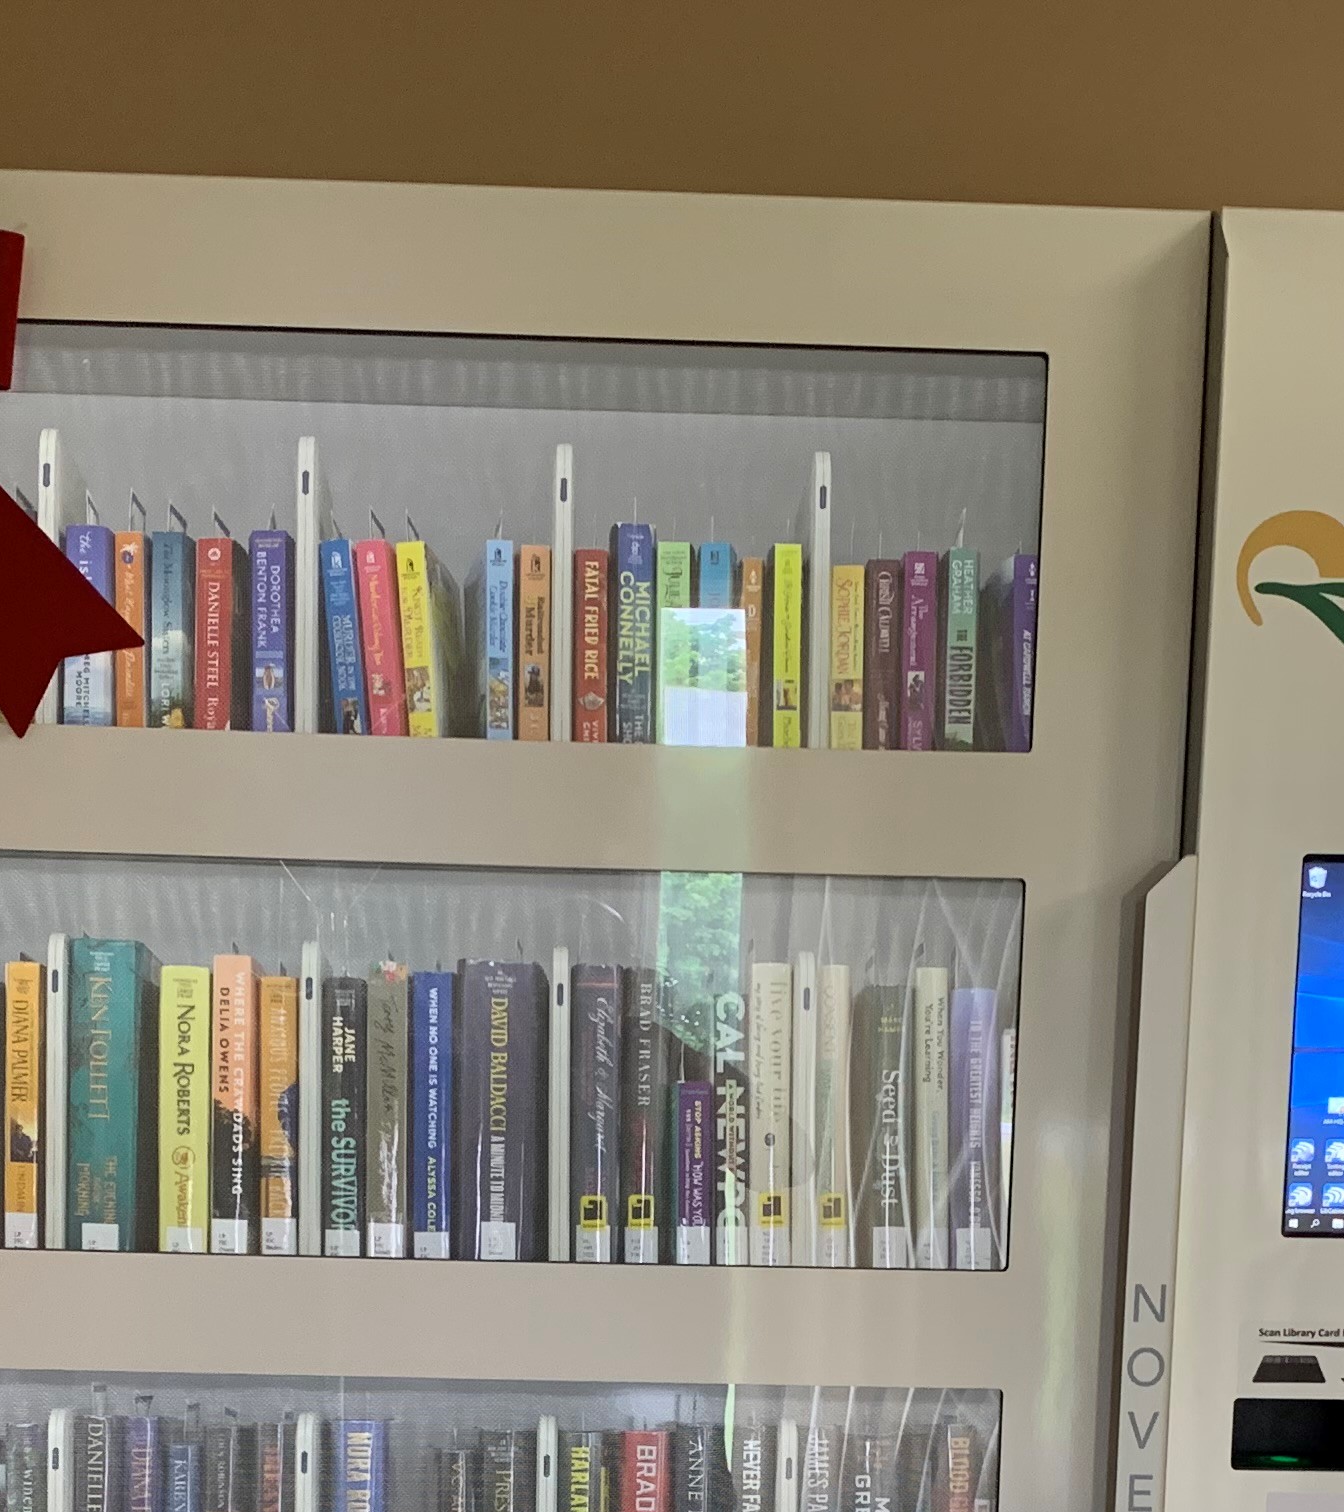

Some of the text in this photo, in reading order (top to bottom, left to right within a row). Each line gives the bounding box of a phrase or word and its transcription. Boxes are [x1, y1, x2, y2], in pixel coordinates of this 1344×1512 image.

[256, 551, 267, 648] BENTON FRANK
[270, 565, 280, 633] DOROTHEA
[584, 561, 600, 680] FATAL FRIED RICE
[951, 560, 963, 614] GRAHAM
[963, 560, 974, 614] HEATHER
[206, 582, 219, 688] DANIELLE STEEL
[618, 571, 634, 685] CONNELLY
[634, 582, 650, 677] MICHAEL
[837, 579, 852, 675] SOPHIE JORDAN
[948, 646, 973, 724] FORBIDDEN
[428, 988, 438, 1023] WHEN
[428, 1026, 437, 1044] NO
[11, 1000, 28, 1102] DIANA PALMER
[218, 987, 229, 1093] DELIA OWENS
[332, 1017, 343, 1073] HARPER
[345, 1027, 356, 1062] JANE
[428, 1047, 437, 1071] ONE
[489, 997, 508, 1131] DAVID BALDACCI
[638, 983, 653, 1106] BRAD FRASER
[231, 973, 245, 1195] WHERE THE CRAWDADS SING
[428, 1074, 437, 1085] IS
[331, 1099, 350, 1130] the
[427, 1088, 437, 1148] WATCHING
[880, 1069, 901, 1207] Seed Dust
[427, 1156, 436, 1198] ALYSSA
[1259, 1328, 1280, 1337] Scan
[1283, 1328, 1316, 1338] Library
[1318, 1329, 1340, 1337] Card
[86, 1423, 103, 1512] DANIELLE
[635, 1445, 656, 1512] BRAD
[688, 1440, 704, 1501] ANNE
[743, 1440, 761, 1490] NEVER
